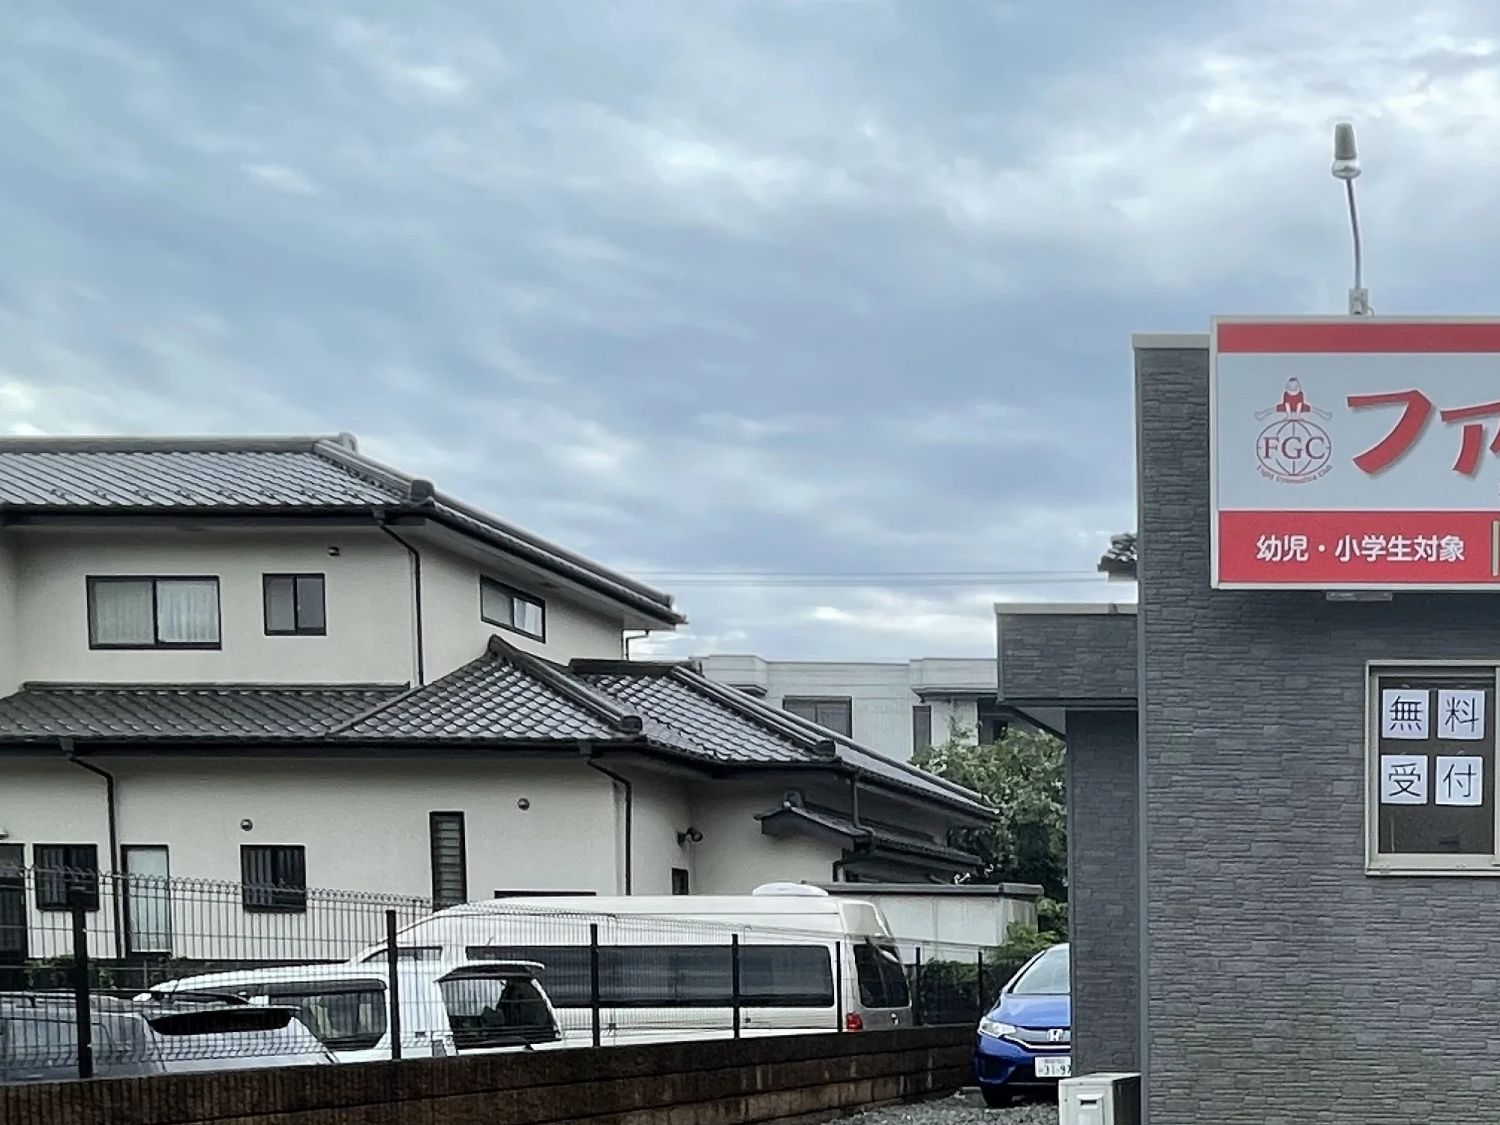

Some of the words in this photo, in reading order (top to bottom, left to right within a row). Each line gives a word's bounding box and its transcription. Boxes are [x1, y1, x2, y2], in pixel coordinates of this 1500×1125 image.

[1263, 435, 1326, 460] FGC
[1256, 534, 1466, 563] 幼児・小学生対象
